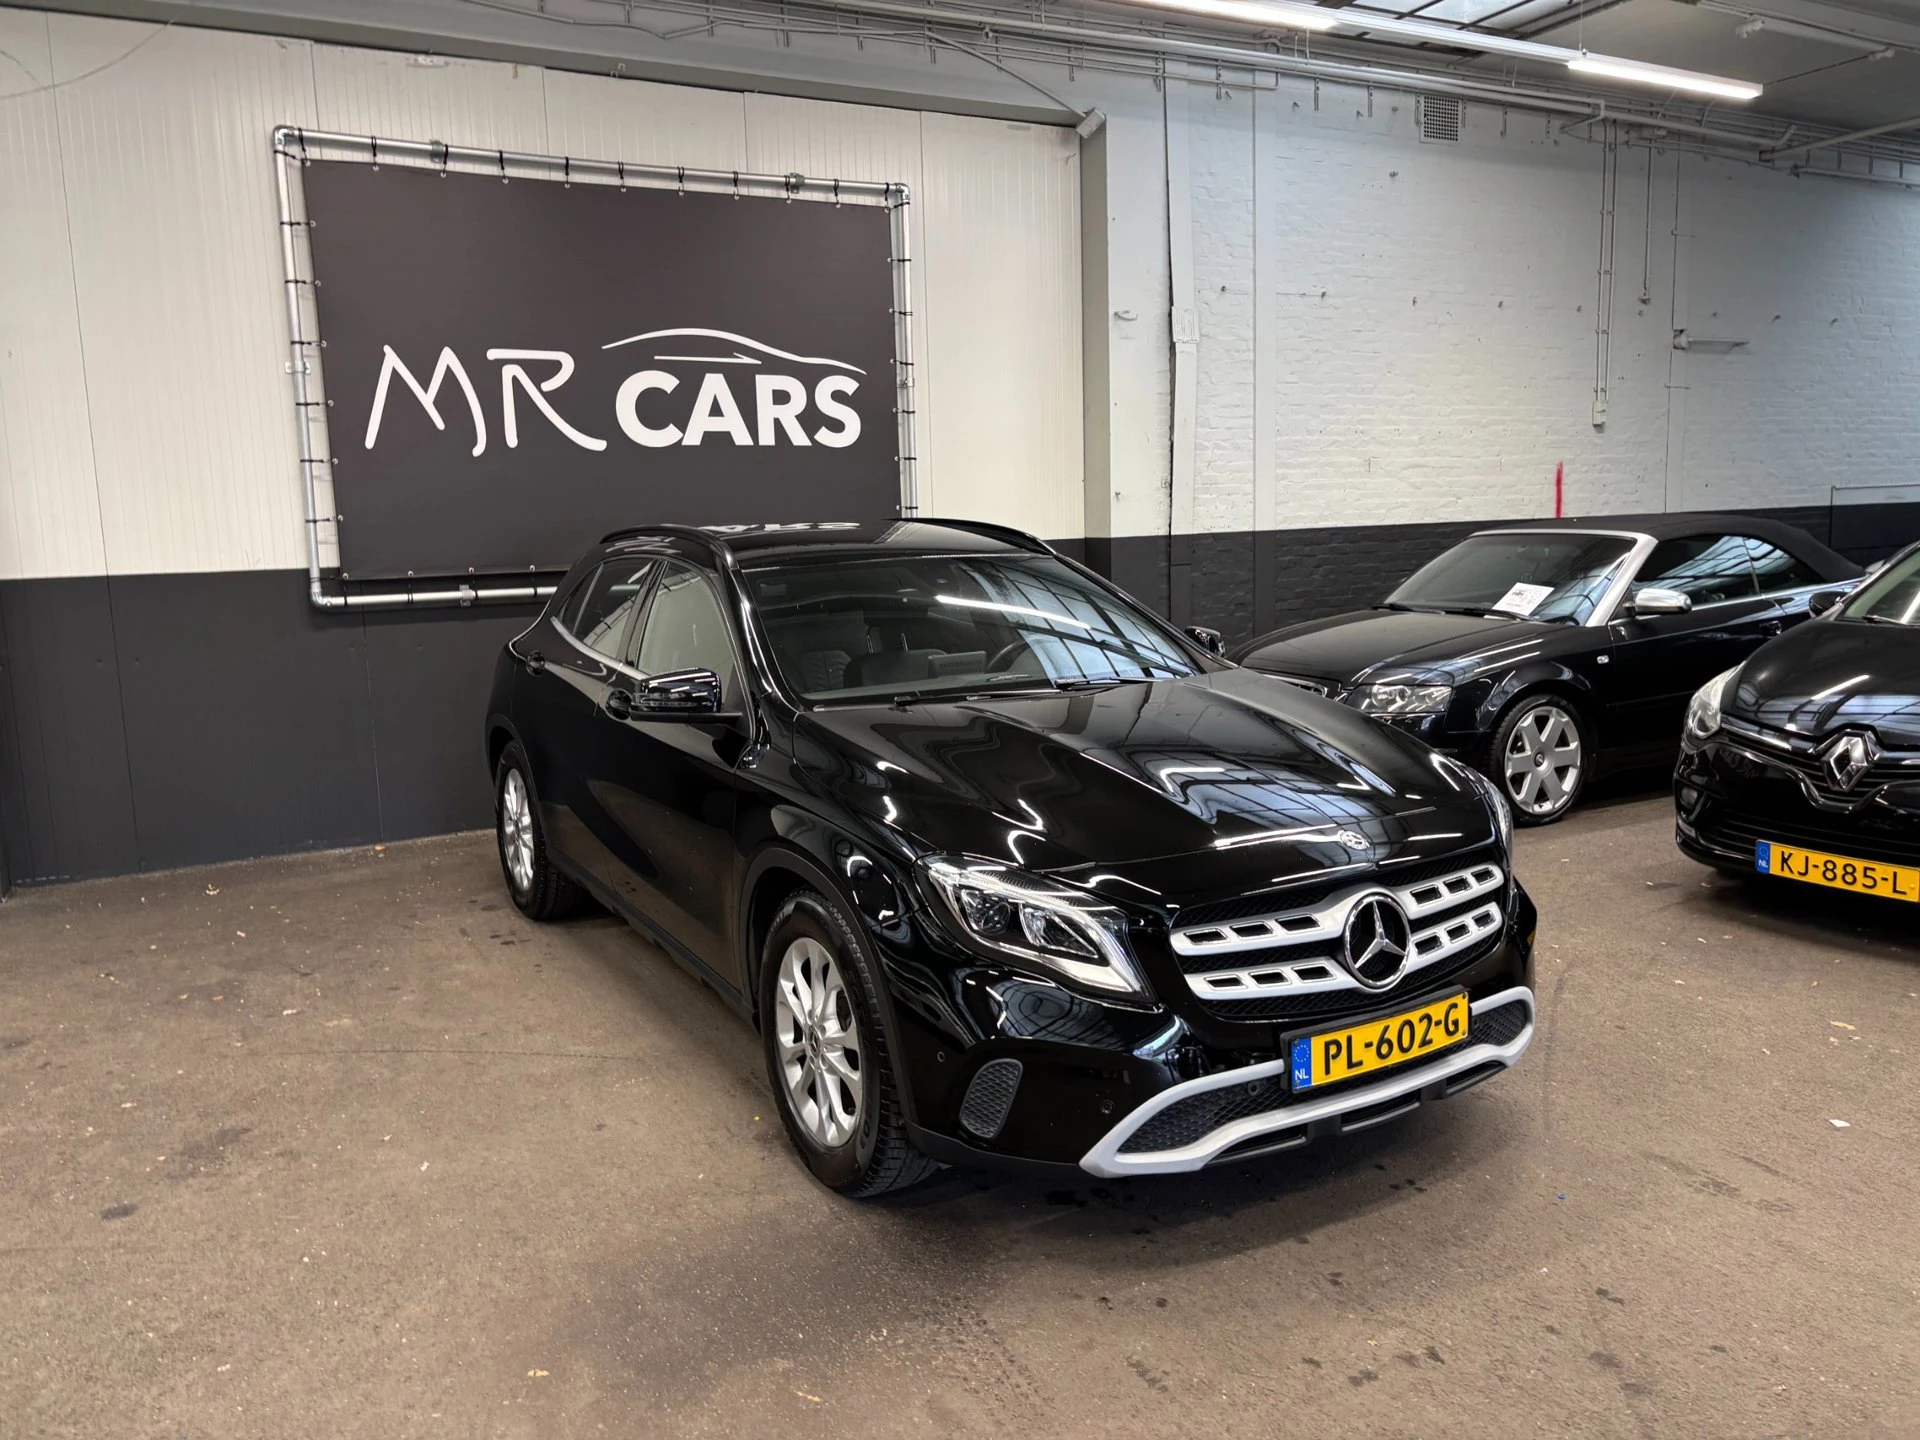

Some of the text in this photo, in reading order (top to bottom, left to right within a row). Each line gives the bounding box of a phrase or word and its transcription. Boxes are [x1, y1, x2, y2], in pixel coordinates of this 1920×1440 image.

[365, 344, 863, 457] MR CARS
[1758, 859, 1768, 868] NL
[1780, 850, 1907, 895] KJ-885-L
[1323, 1002, 1460, 1076] PL-602-G
[1295, 1069, 1309, 1080] NL
